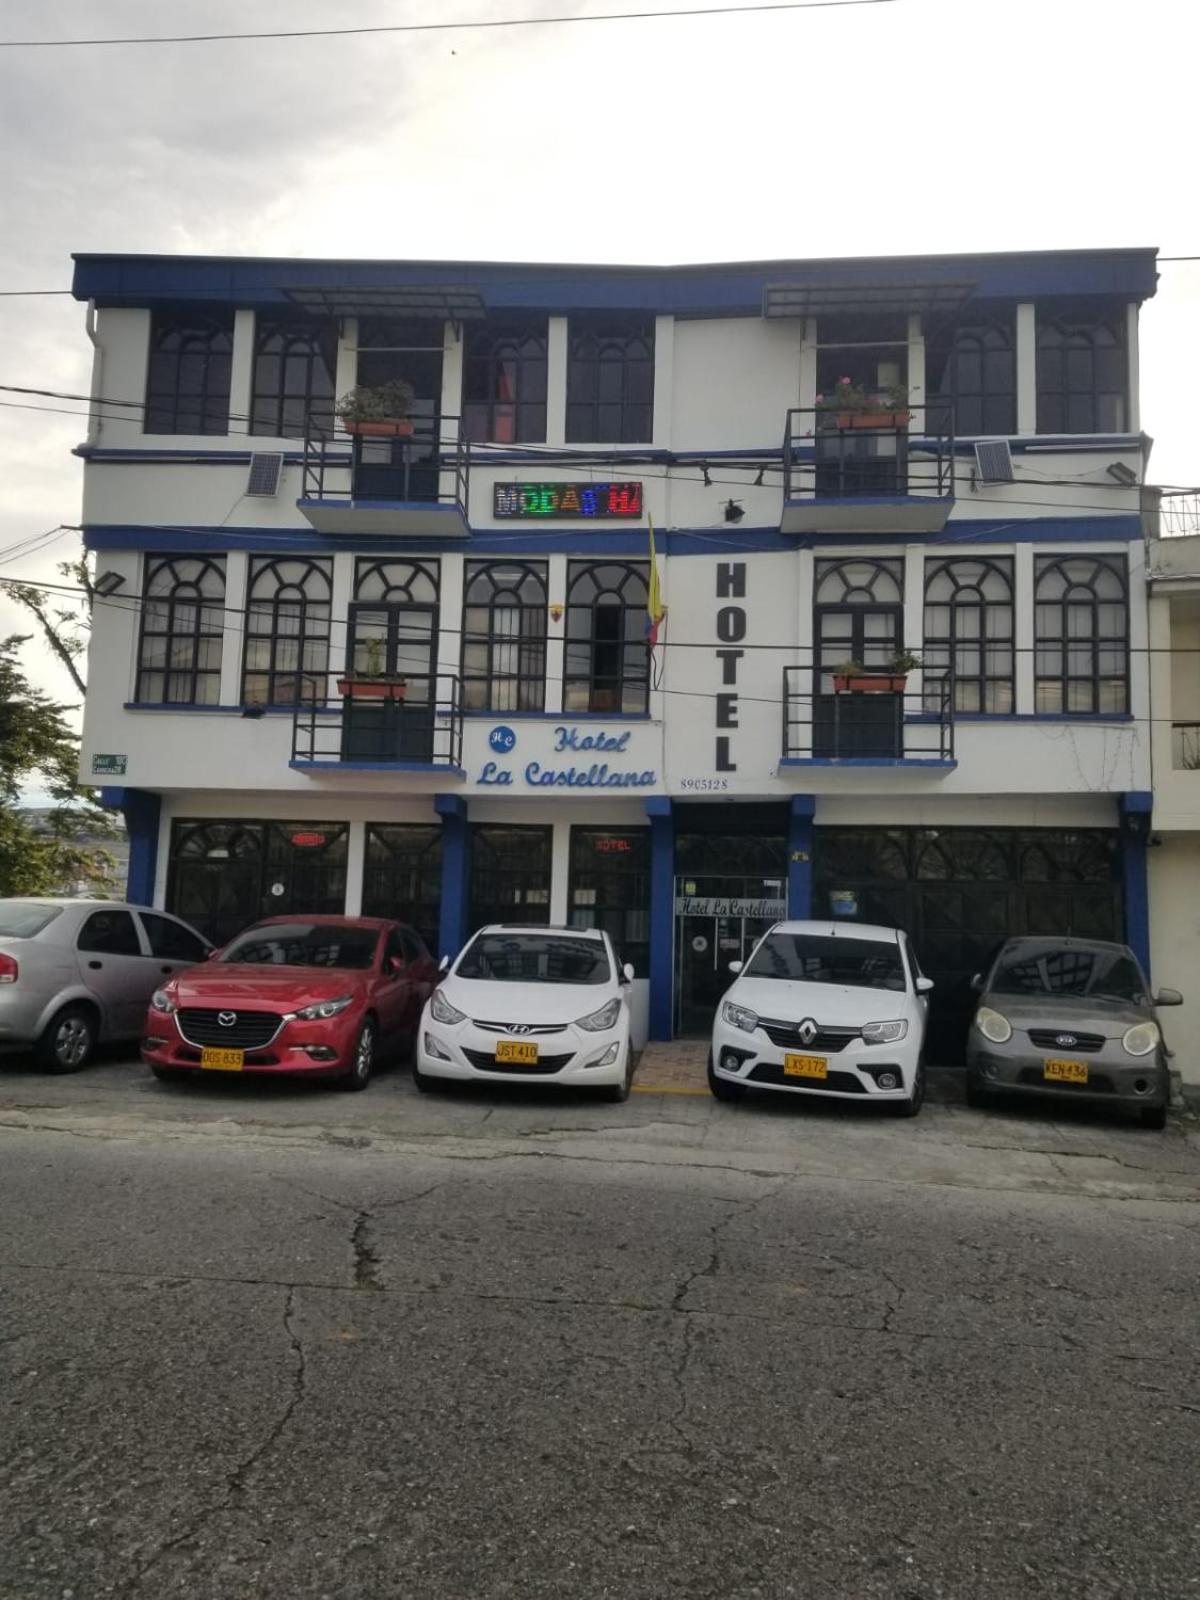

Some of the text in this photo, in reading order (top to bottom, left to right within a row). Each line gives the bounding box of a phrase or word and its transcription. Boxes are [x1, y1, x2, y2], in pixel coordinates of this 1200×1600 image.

[716, 562, 747, 772] HOTEL
[554, 727, 631, 752] Hotel
[476, 762, 656, 787] La Castellana
[681, 898, 785, 918] Hotel La Castellana
